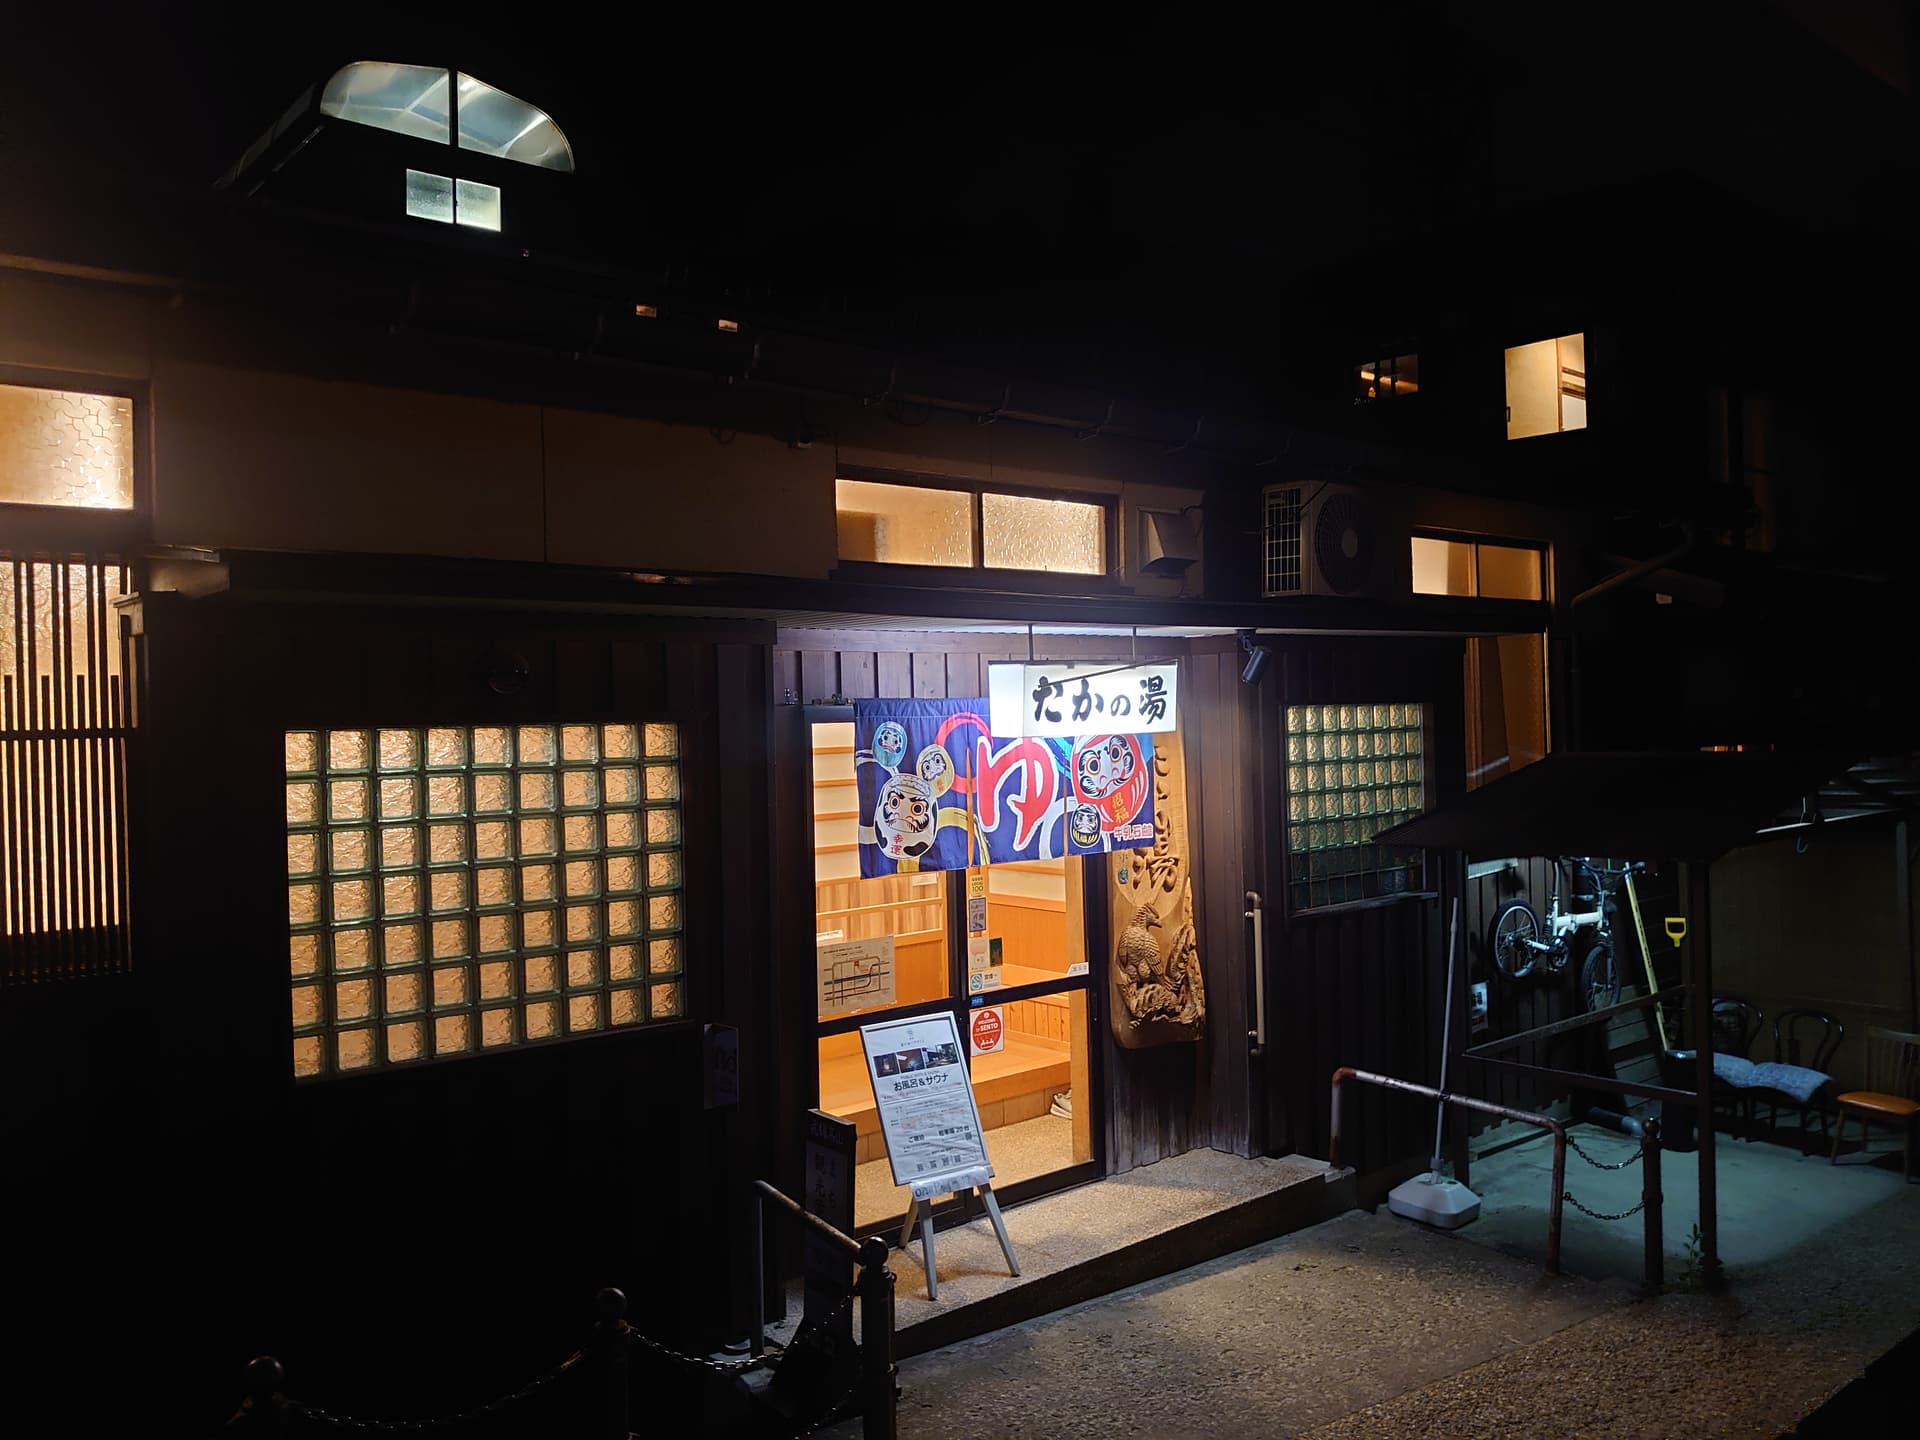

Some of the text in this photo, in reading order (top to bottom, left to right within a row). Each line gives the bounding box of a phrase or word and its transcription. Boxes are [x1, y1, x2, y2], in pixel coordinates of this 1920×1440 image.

[1032, 675, 1168, 724] たかの湯
[977, 736, 1058, 852] ゆ
[1112, 792, 1130, 823] 招福
[1114, 823, 1154, 842] 牛乳石鹸
[980, 1022, 999, 1032] SENTO
